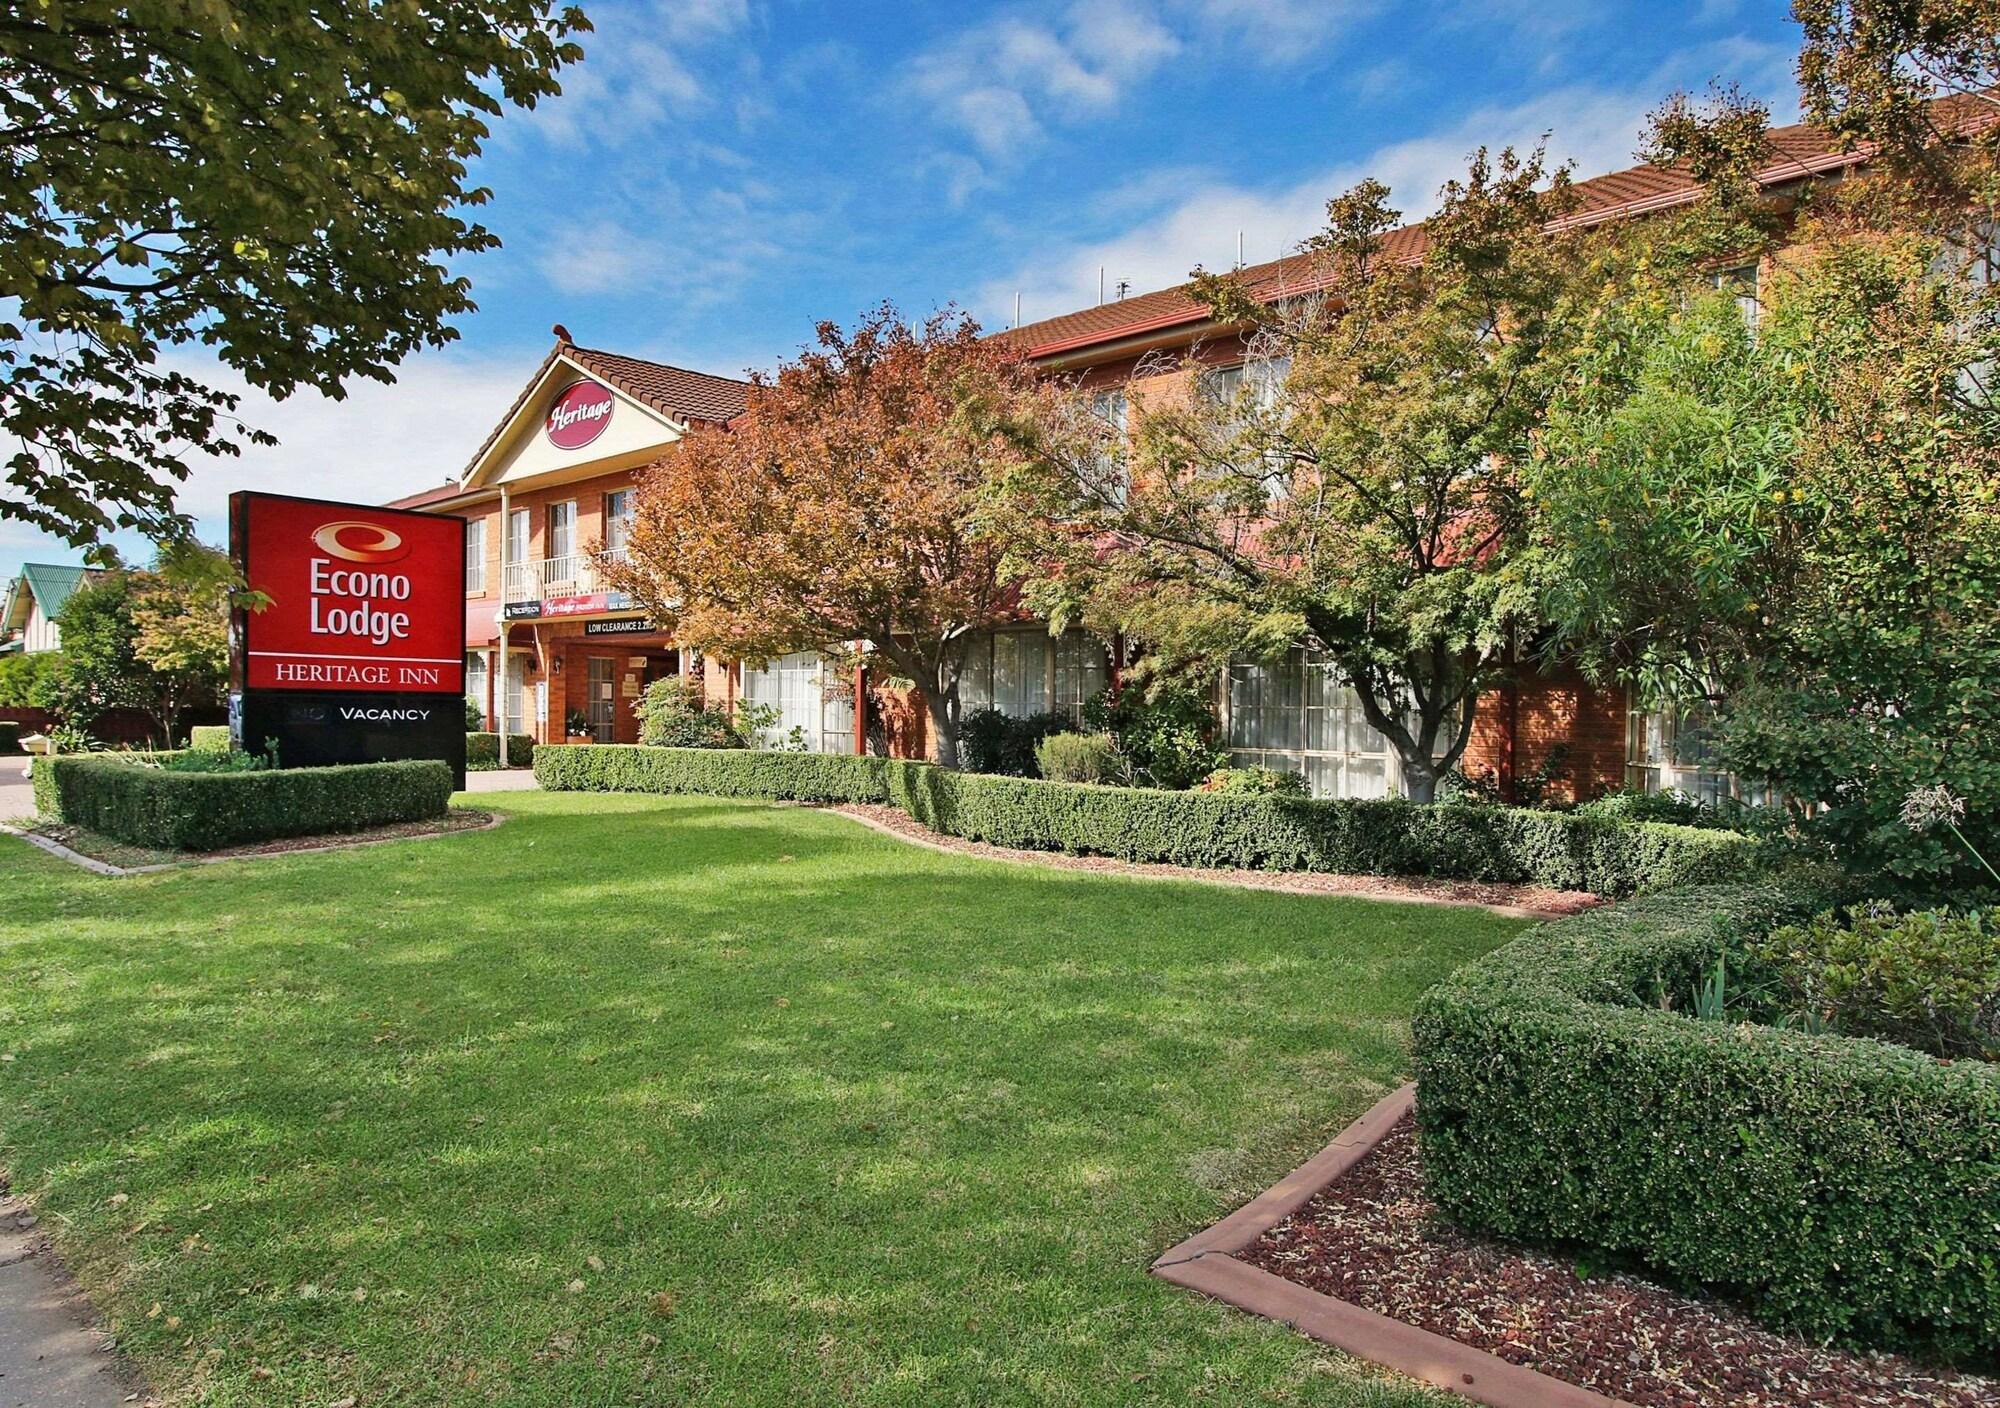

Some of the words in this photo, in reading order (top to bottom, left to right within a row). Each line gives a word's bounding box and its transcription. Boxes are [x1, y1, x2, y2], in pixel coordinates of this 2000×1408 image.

[548, 400, 612, 433] Heritage
[310, 558, 411, 601] Econo
[545, 600, 575, 616] Heritage
[310, 597, 410, 646] Lodge
[588, 623, 601, 633] LOW
[602, 621, 637, 632] CLEARANCE
[275, 663, 392, 684] HERITAGE
[399, 667, 440, 685] INN
[339, 707, 430, 721] VACANCY
